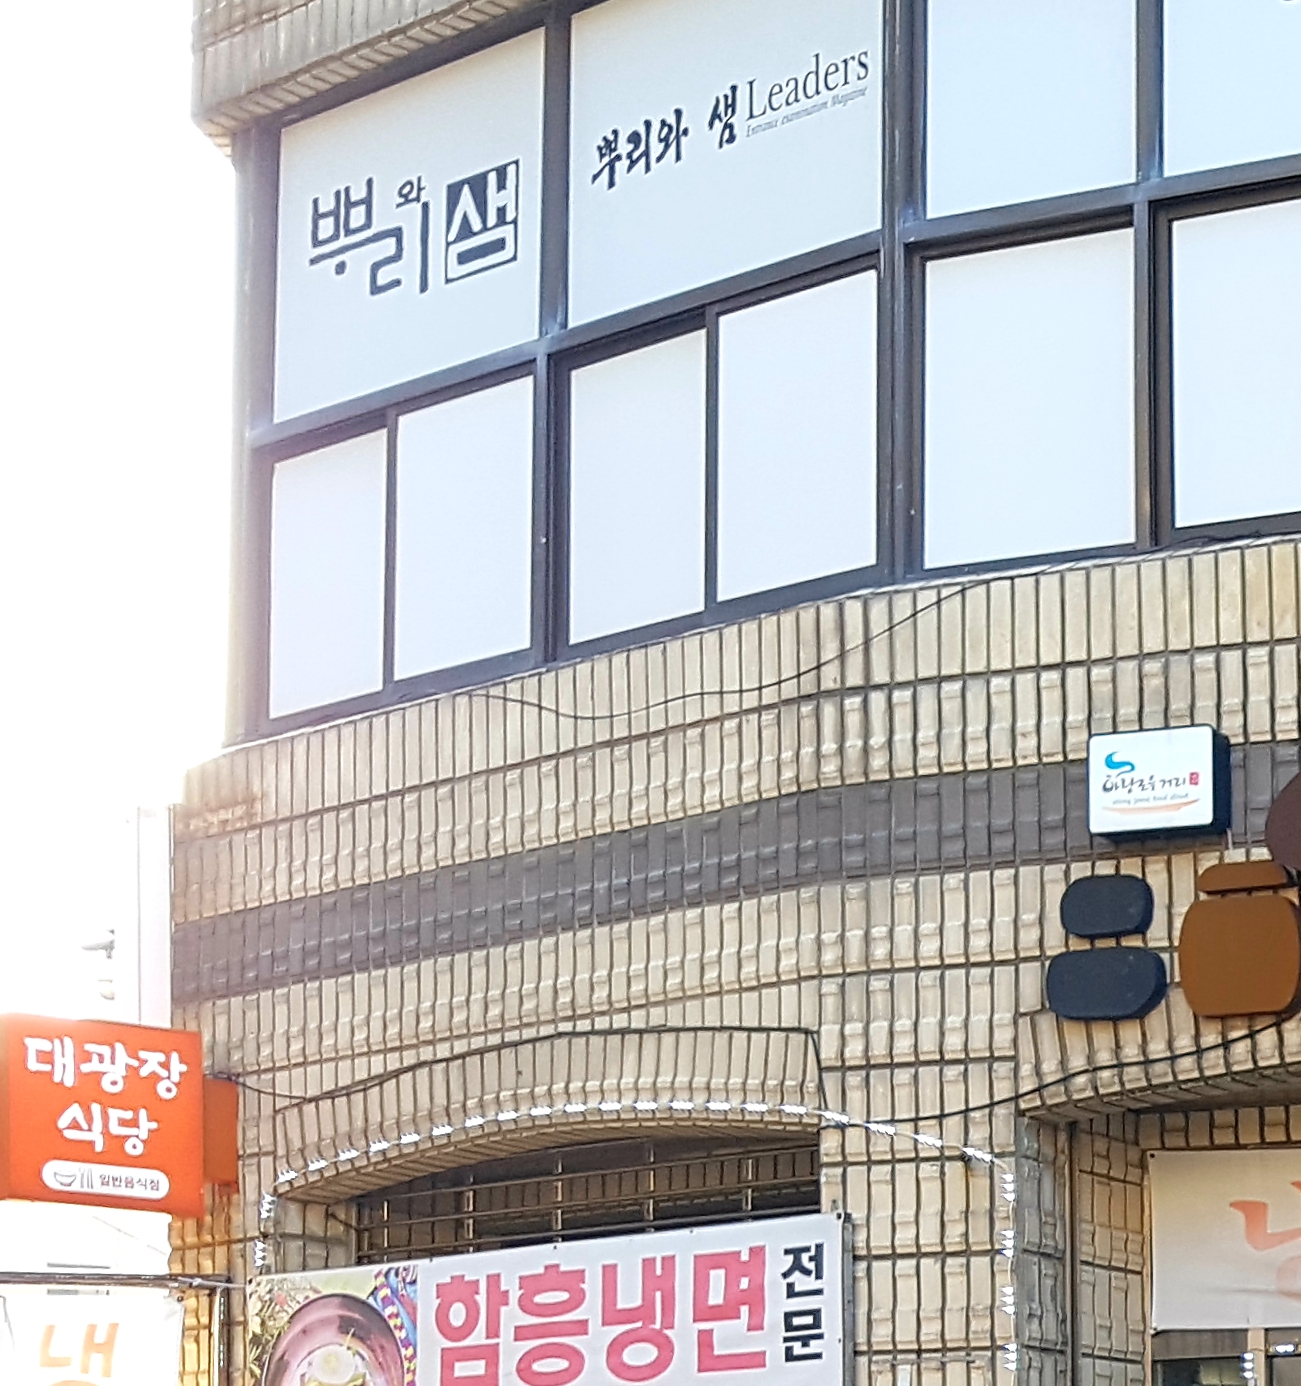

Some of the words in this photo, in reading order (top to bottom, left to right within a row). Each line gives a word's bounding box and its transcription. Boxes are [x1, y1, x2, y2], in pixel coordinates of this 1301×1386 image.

[745, 50, 870, 121] Leaders
[24, 1036, 187, 1099] 대광장
[57, 1102, 158, 1156] 식당
[99, 1173, 160, 1191] 일반음식점
[782, 1243, 826, 1363] 전문
